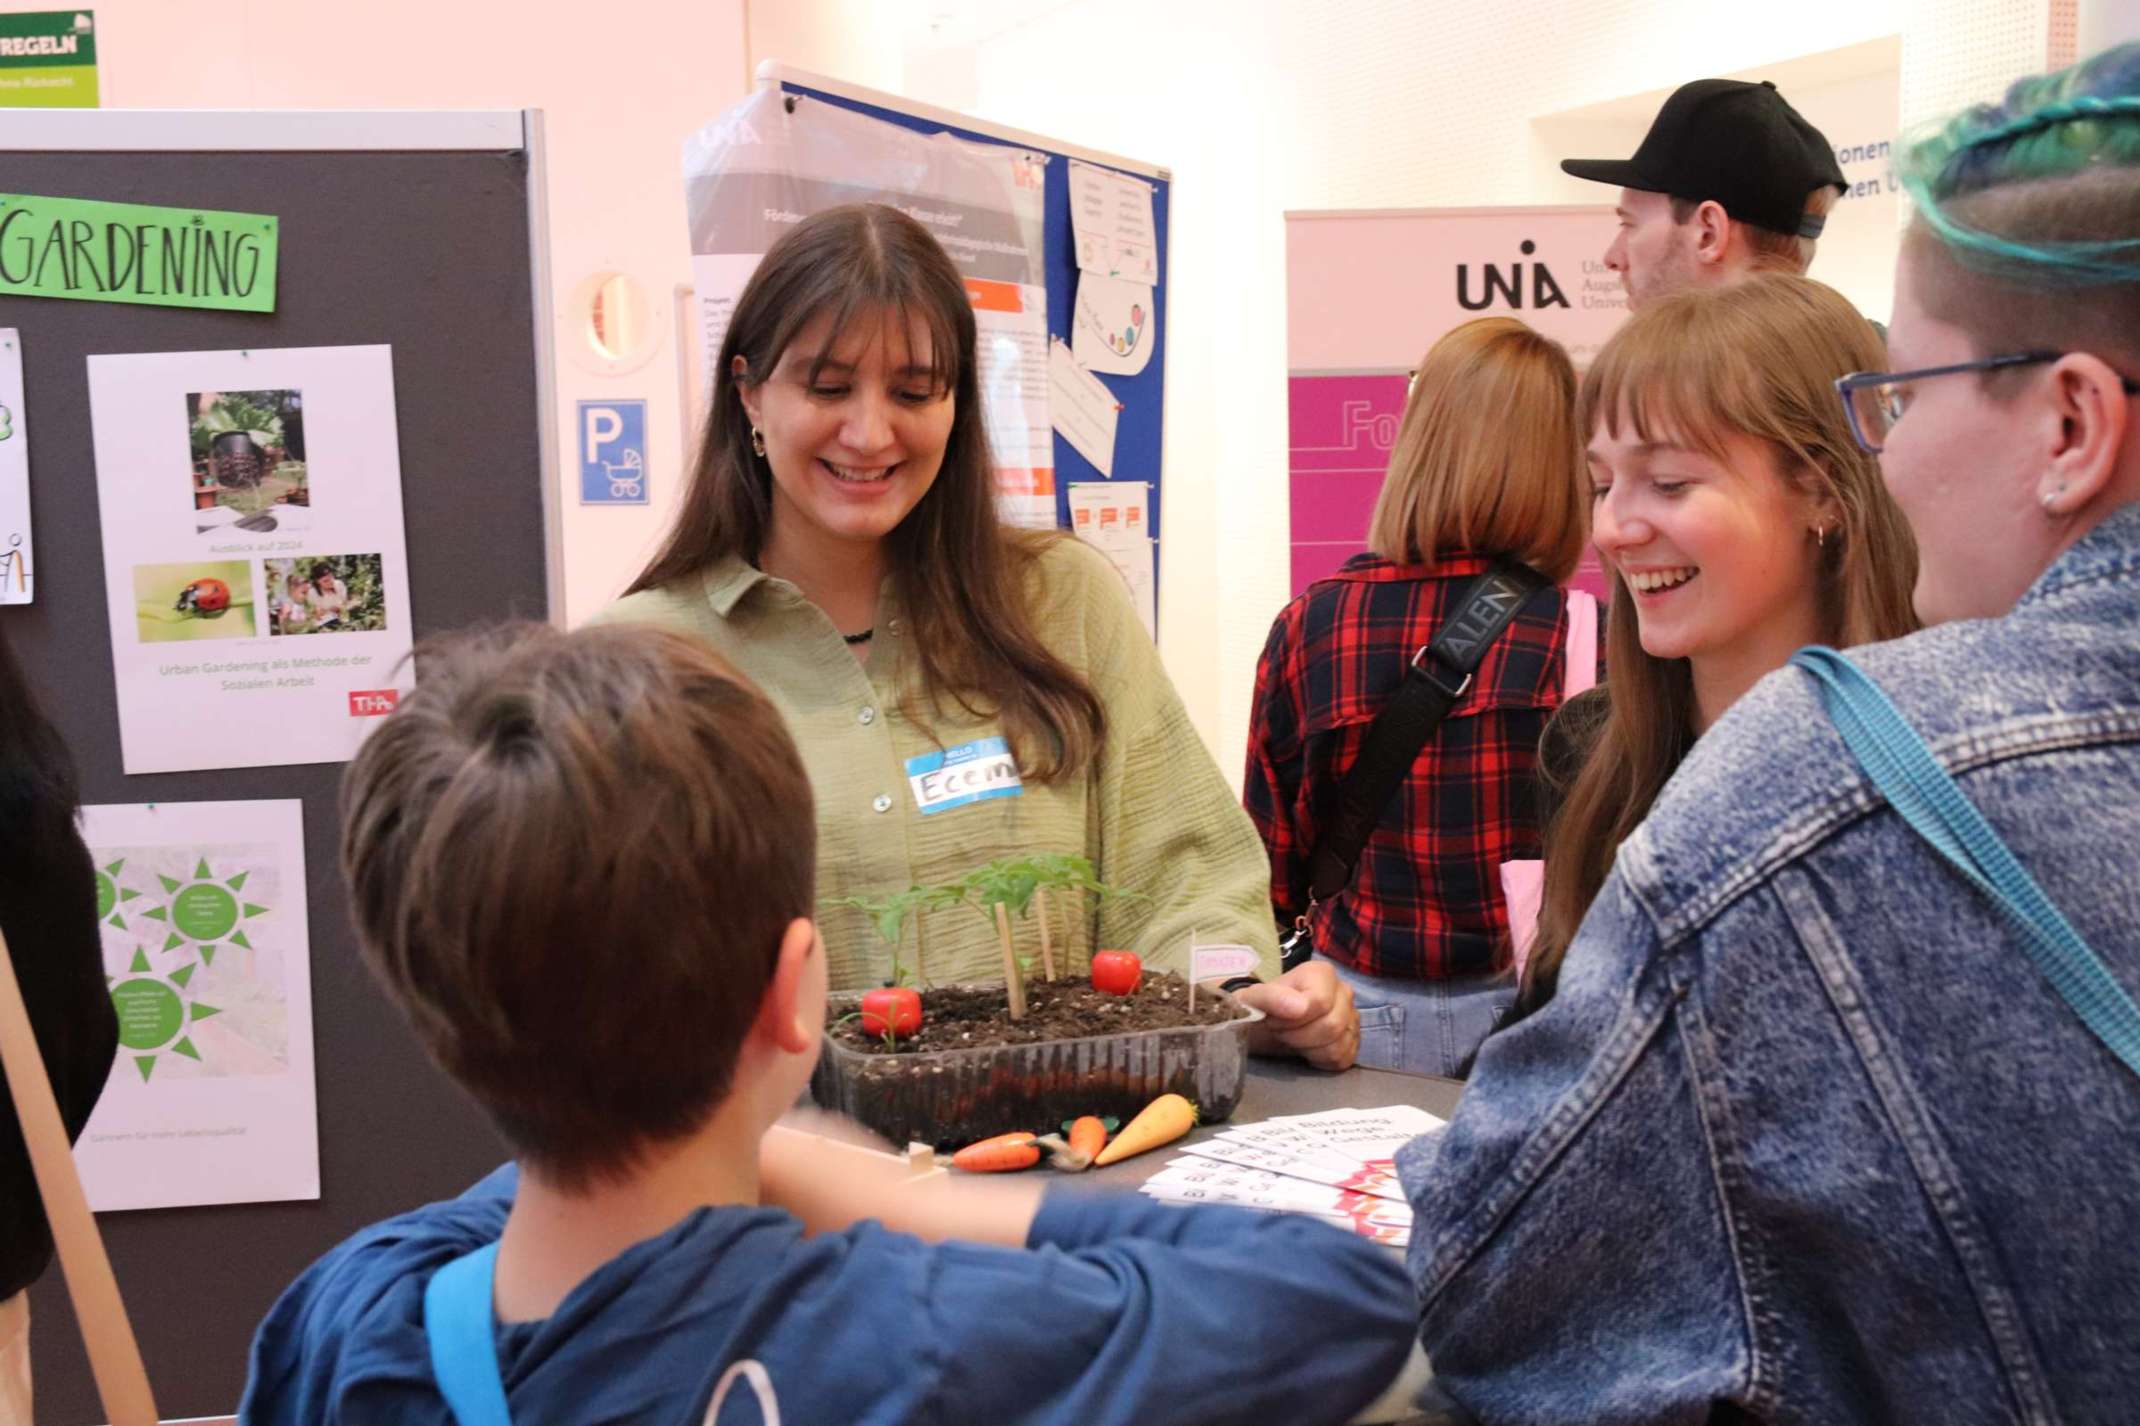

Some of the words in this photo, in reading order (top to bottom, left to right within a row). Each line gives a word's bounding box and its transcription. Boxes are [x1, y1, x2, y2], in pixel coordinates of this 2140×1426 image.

[0, 35, 77, 56] REGELN
[0, 209, 260, 298] GARDENING
[587, 408, 623, 464] P
[1441, 580, 1518, 661] ALEN
[159, 663, 199, 676] Urban
[202, 660, 268, 674] Gardening
[271, 658, 289, 669] als
[292, 656, 347, 669] Methode
[351, 655, 372, 665] der
[221, 679, 273, 691] Sozialen
[276, 677, 314, 688] Arbeit
